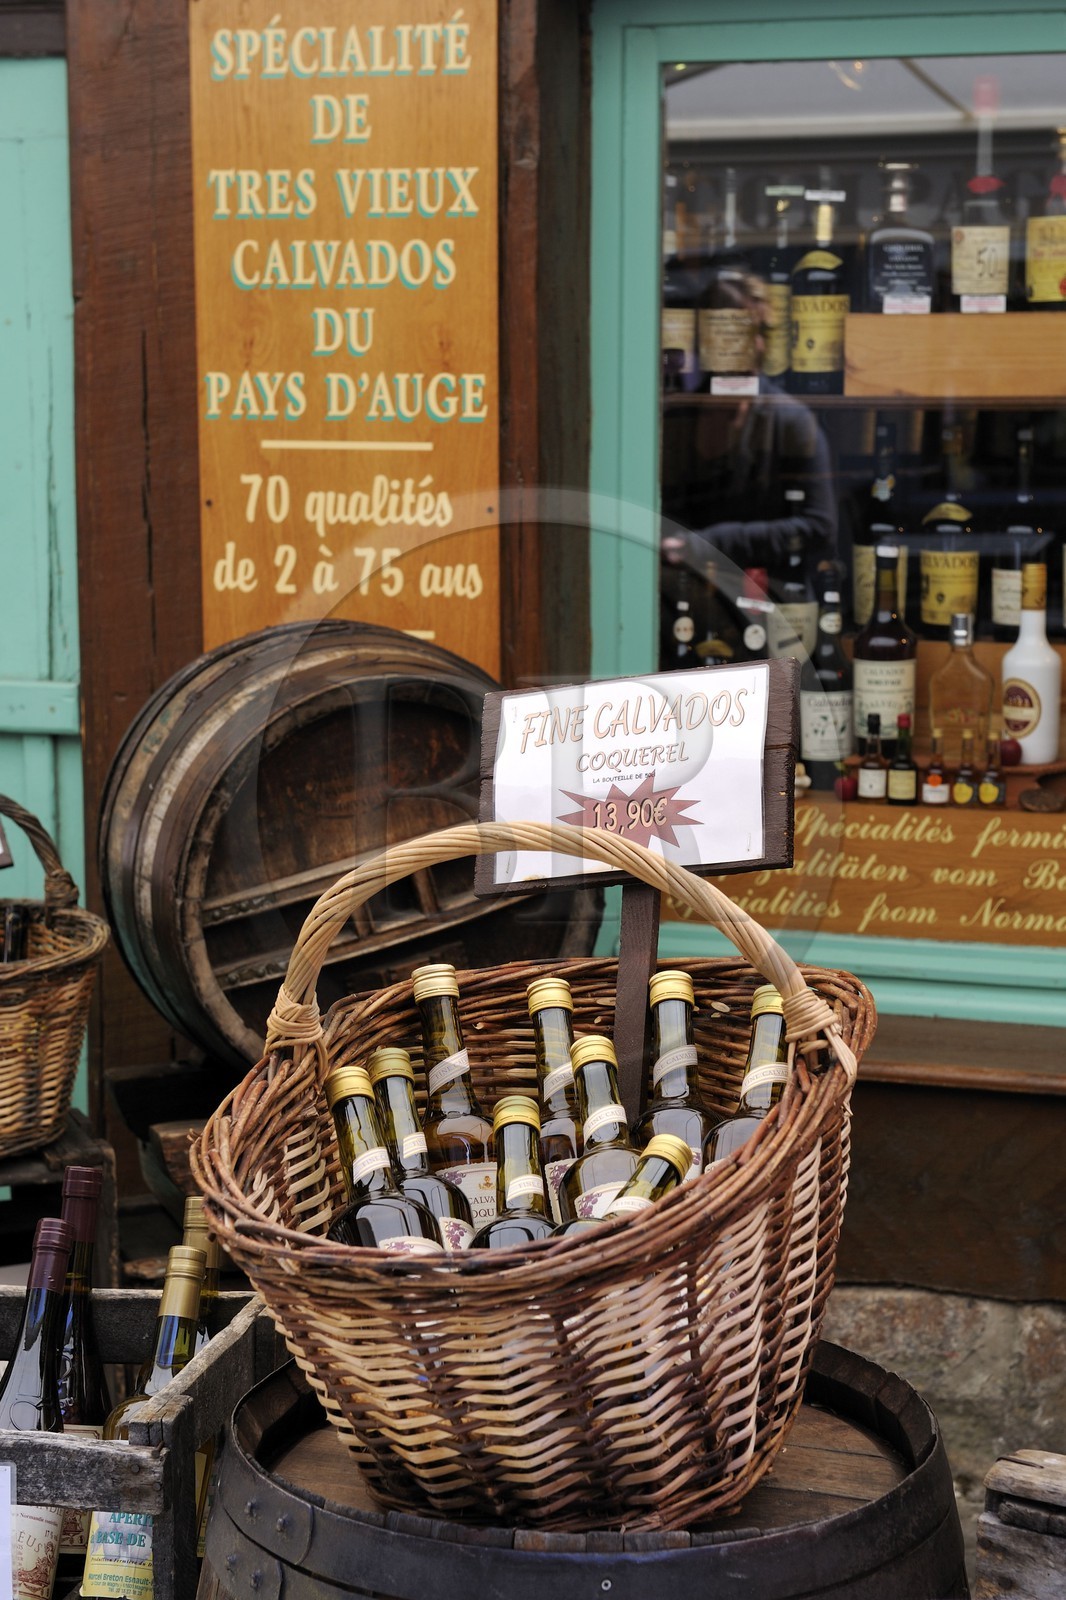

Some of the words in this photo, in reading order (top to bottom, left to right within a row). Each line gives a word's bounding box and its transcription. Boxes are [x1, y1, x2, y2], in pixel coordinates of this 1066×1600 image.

[211, 8, 472, 80] SPÉCIALITÉ
[310, 93, 372, 144] DE
[207, 168, 318, 219] TRES
[335, 167, 480, 218] VIEUX
[231, 238, 457, 290] CALVADOS
[312, 307, 375, 356] DU
[204, 370, 307, 421] PAYS
[240, 474, 290, 523] 70
[304, 474, 454, 537] qualités
[213, 541, 258, 593] de
[274, 544, 297, 594] 2
[312, 544, 339, 594] à
[353, 547, 404, 597] 75
[419, 562, 483, 599] ans
[519, 704, 589, 755] FINE
[593, 688, 748, 740] CALVADOS
[575, 741, 689, 774] COQUEREL
[602, 774, 633, 783] BOUTEILLE
[592, 796, 668, 835] 13,90€
[794, 806, 956, 847] Spécialités
[931, 866, 998, 887] vom
[857, 892, 939, 933] from
[96, 1531, 123, 1545] BASE
[127, 1532, 146, 1548] DE
[103, 1573, 123, 1581] Breton
